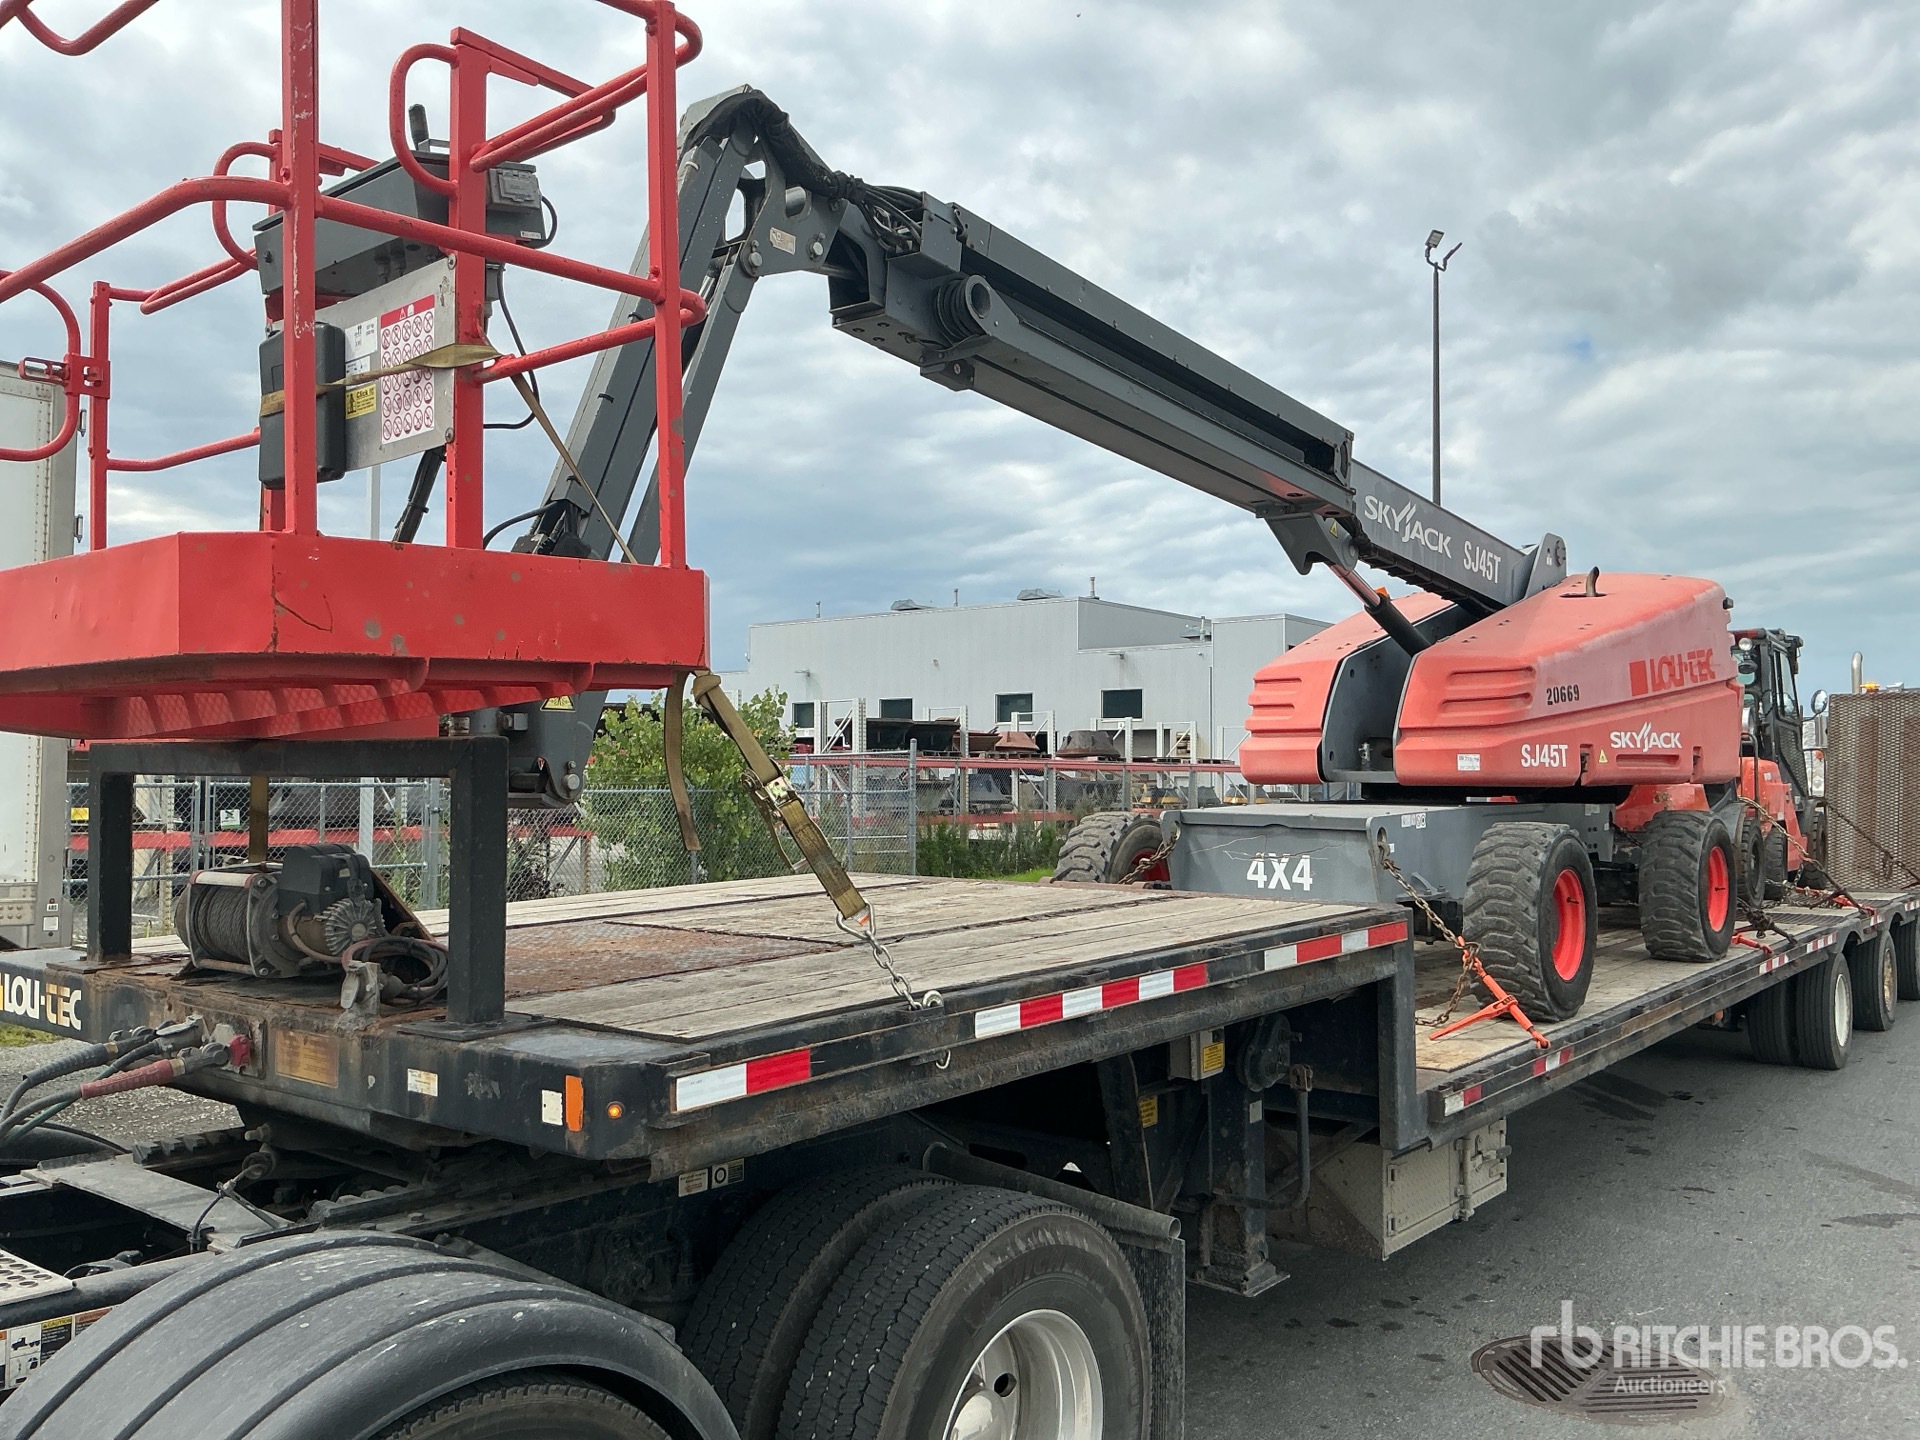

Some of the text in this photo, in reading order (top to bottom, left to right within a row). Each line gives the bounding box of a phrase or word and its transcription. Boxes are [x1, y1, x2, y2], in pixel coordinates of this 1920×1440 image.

[1364, 495, 1501, 584] SKYJACK SJ45T
[1650, 648, 1716, 692] LOU-TEC
[1546, 684, 1580, 705] 20669
[1521, 743, 1568, 767] SJ45T
[1610, 722, 1682, 752] SKYJACK
[1246, 852, 1313, 891] 4X4
[4, 973, 82, 1031] LOU-TEC
